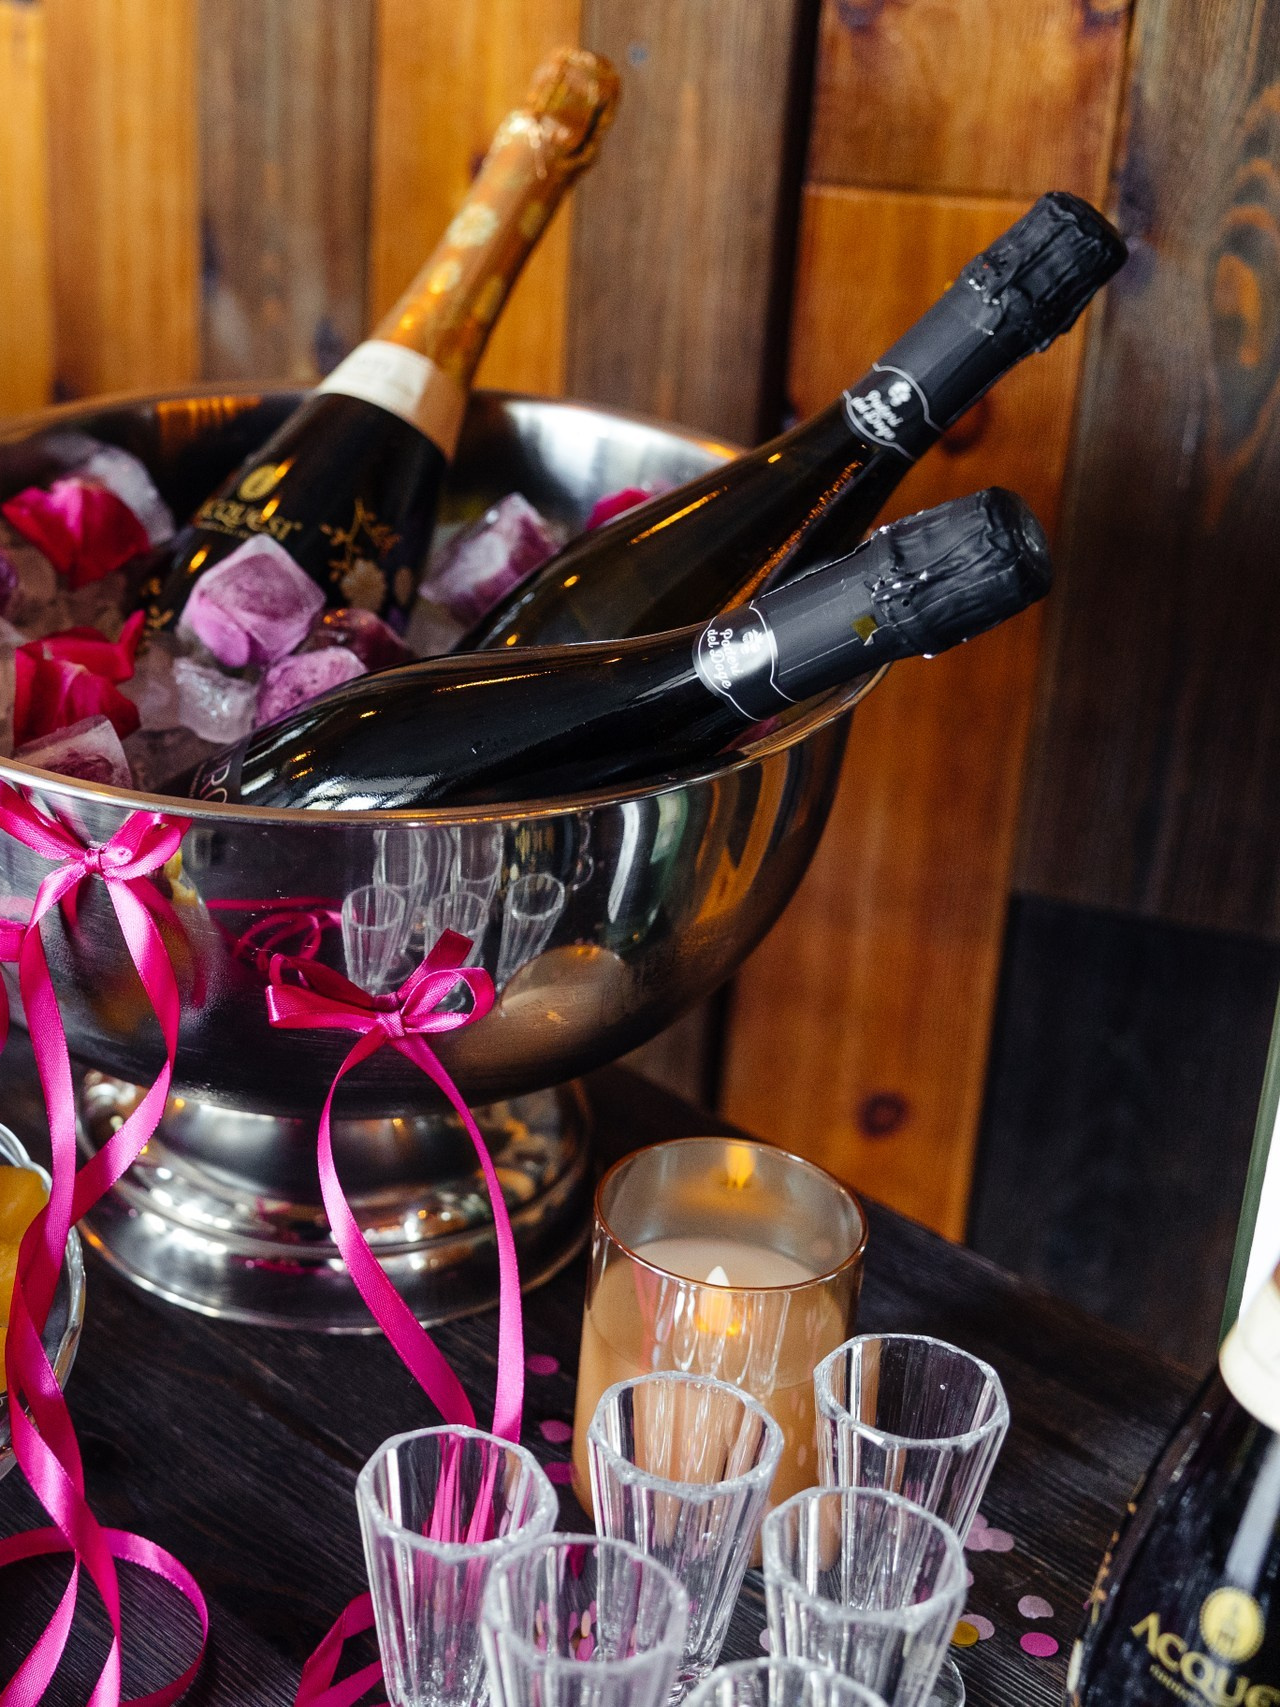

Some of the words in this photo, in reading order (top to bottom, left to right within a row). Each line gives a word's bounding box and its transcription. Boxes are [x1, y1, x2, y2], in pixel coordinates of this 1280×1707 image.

[707, 629, 720, 648] del
[719, 628, 744, 677] Poderi
[710, 649, 732, 689] Doge
